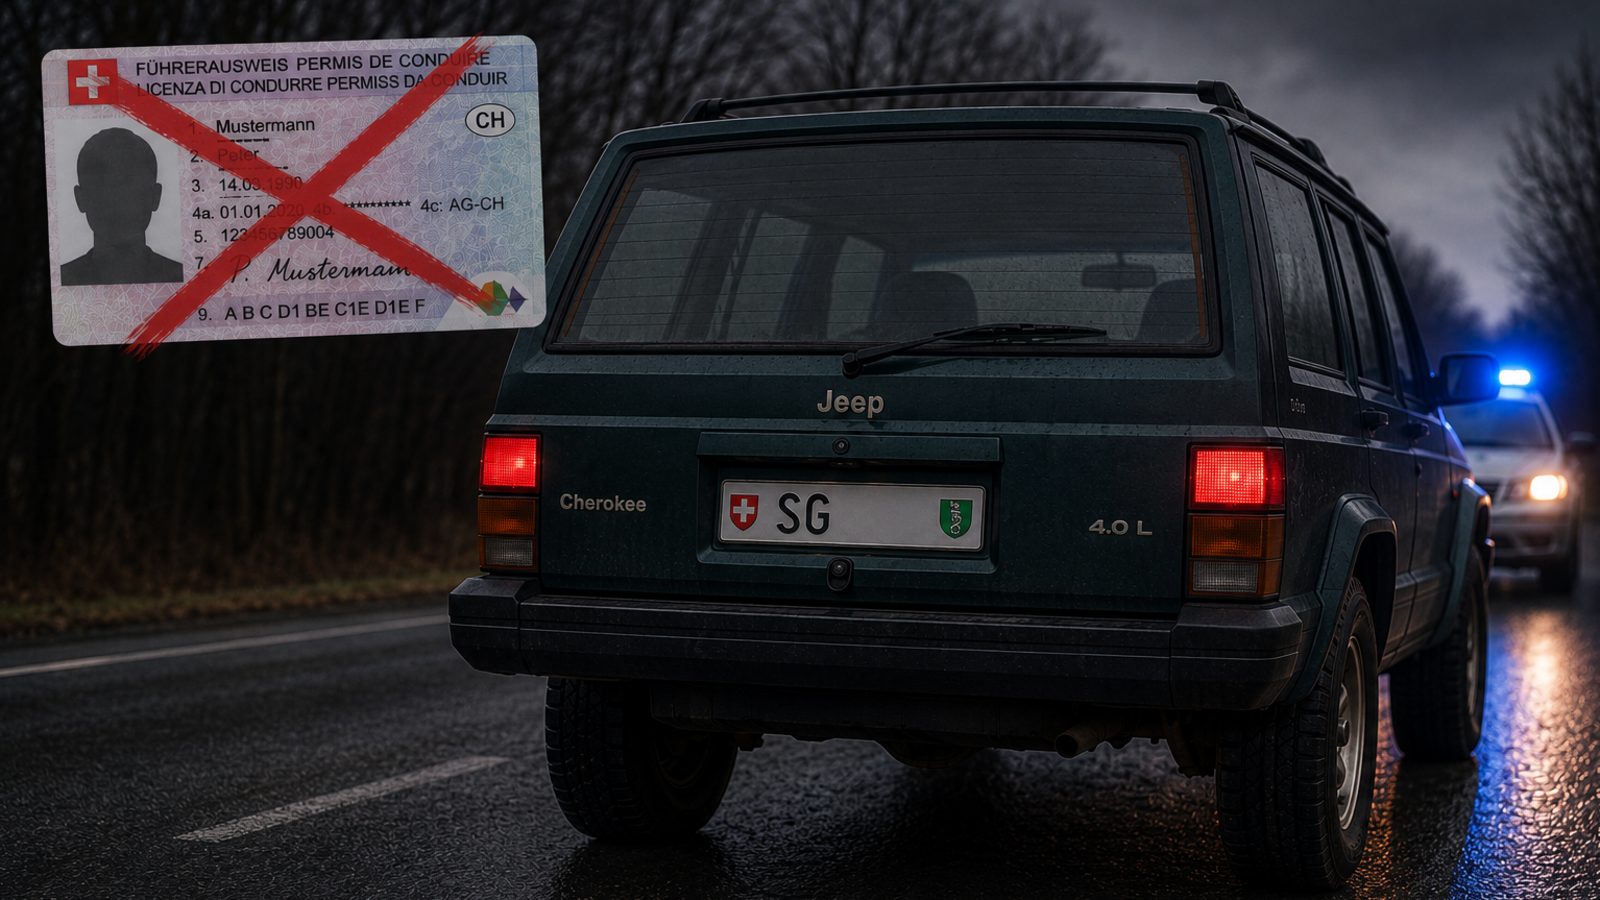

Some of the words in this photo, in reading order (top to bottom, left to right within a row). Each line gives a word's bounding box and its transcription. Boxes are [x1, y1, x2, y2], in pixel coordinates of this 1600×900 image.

[136, 58, 289, 76] FÜHRERAUSWEIS
[297, 55, 363, 71] PERMIS
[369, 54, 393, 69] DE
[399, 51, 490, 68] CONDUIRE
[137, 81, 206, 97] LICENZA
[210, 80, 226, 94] DI
[230, 77, 323, 94] CONDURRE
[327, 74, 400, 91] PERMISS
[404, 73, 427, 88] DA
[431, 71, 508, 88] CONDUIR
[216, 119, 316, 134] Mustermann
[475, 111, 506, 129] CH
[190, 150, 203, 163] 2.
[217, 148, 260, 162] Peter
[191, 178, 205, 193] 3.
[219, 176, 303, 192] 14.03.1990
[192, 206, 215, 220] 4a.
[219, 203, 305, 219] 01.01.2020
[420, 198, 443, 213] 4c:
[449, 196, 505, 212] AG-CH
[193, 229, 208, 244] 5.
[221, 225, 335, 243] 123456789004
[229, 254, 249, 284] P.
[198, 307, 212, 322] 9.
[224, 306, 238, 321] A
[242, 305, 255, 320] B
[259, 304, 273, 319] C
[278, 304, 299, 319] D1
[305, 302, 330, 318] BE
[334, 301, 369, 316] C1E
[375, 299, 410, 315] D1E
[415, 298, 426, 313] F
[816, 389, 884, 419] Jeep
[559, 493, 647, 512] Cherokee
[776, 492, 830, 535] SG
[1088, 519, 1129, 536] 4.0
[1136, 520, 1153, 536] L
